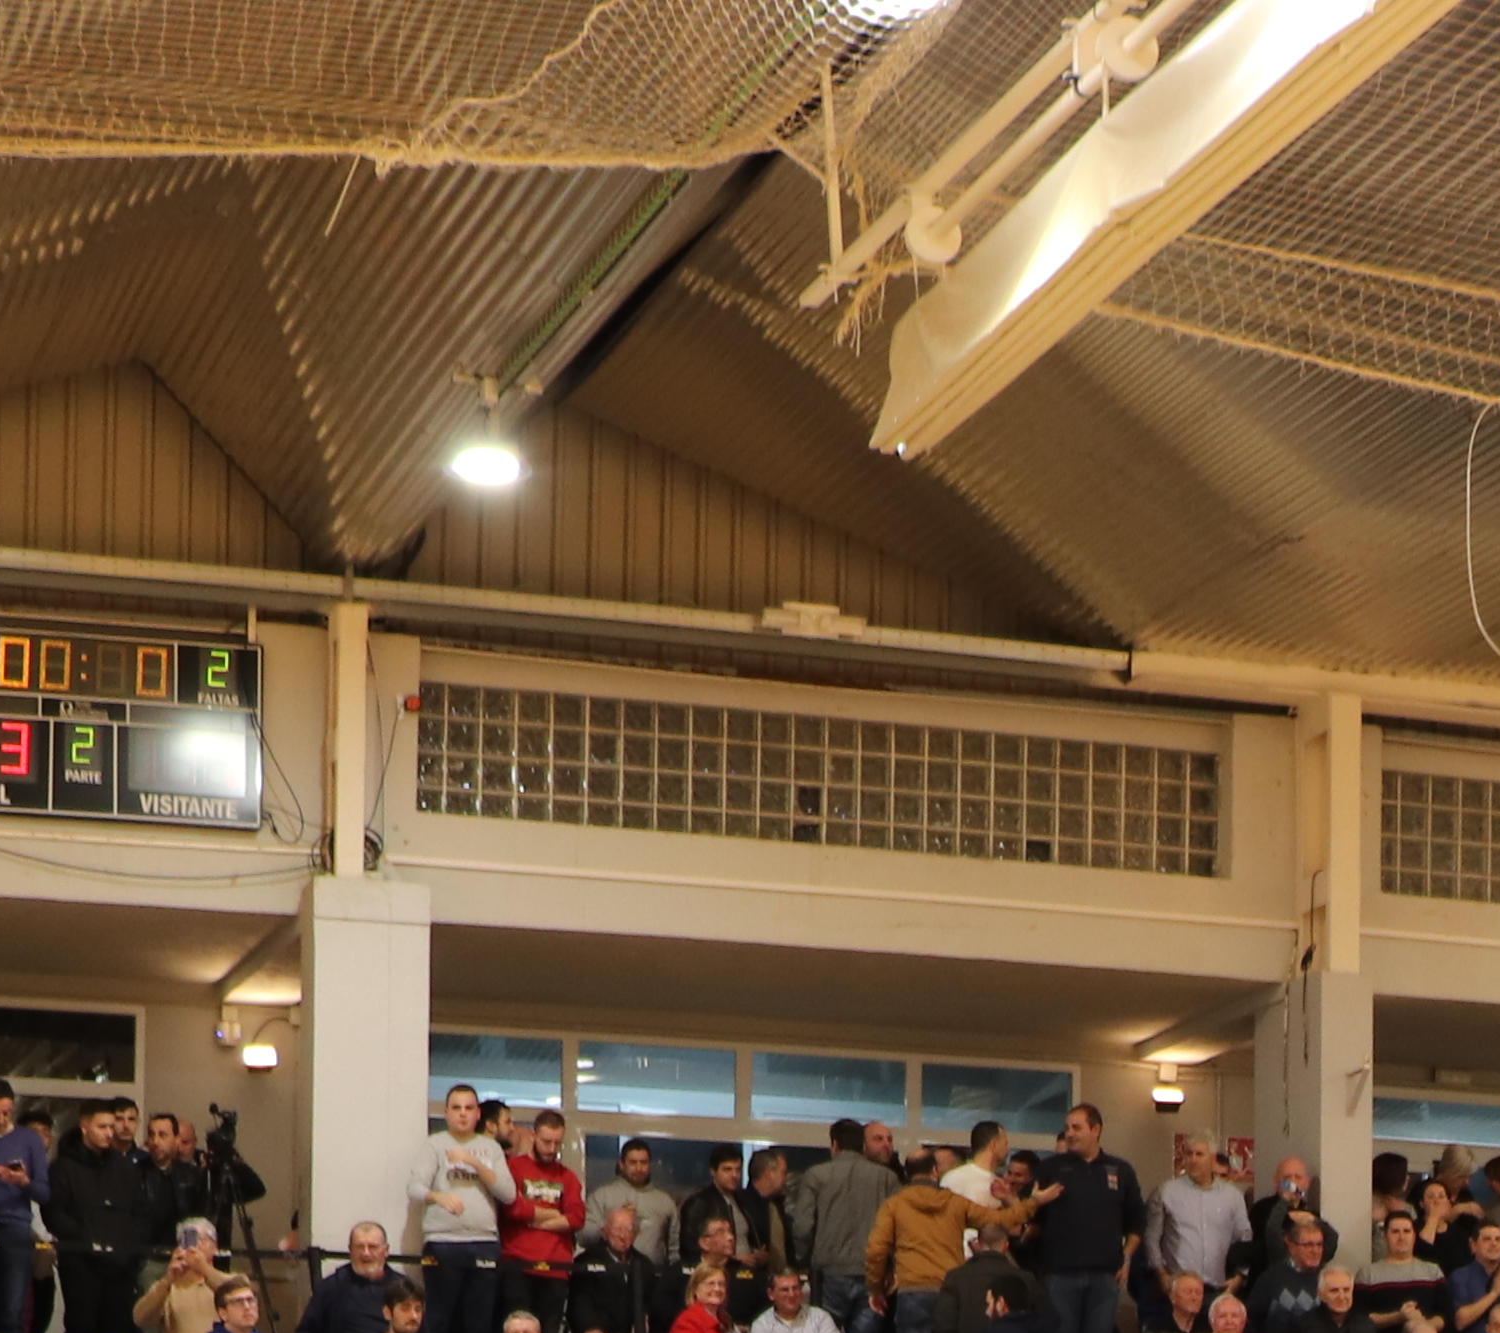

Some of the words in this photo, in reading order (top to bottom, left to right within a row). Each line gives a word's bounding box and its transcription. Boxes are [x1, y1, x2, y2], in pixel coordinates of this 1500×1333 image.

[206, 649, 230, 689] 2
[197, 691, 239, 707] FALTAS
[0, 721, 31, 776] 3
[71, 725, 95, 764] 2
[64, 769, 102, 786] PARTE
[138, 792, 238, 820] VISITANTE
